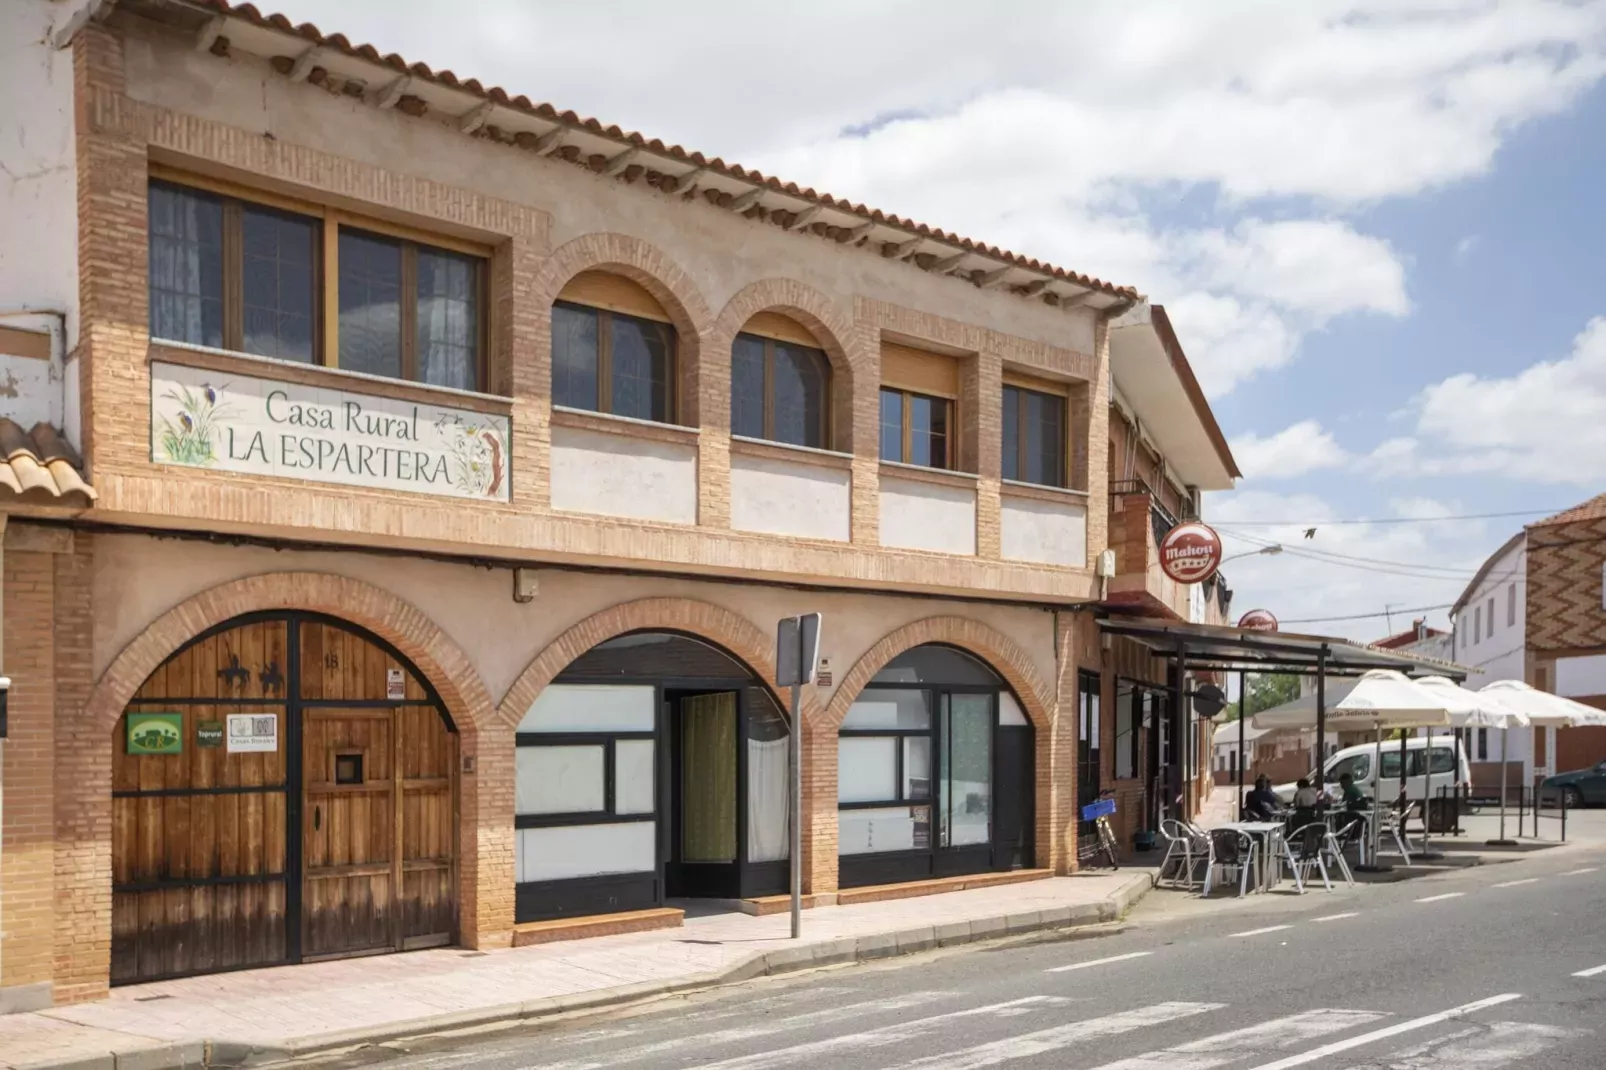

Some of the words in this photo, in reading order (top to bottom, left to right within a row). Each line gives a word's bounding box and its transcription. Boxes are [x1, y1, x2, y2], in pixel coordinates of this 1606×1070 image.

[266, 391, 335, 430] Casa
[344, 401, 420, 442] Rural
[228, 427, 270, 465] LA
[280, 434, 454, 485] ESPARTERA
[1165, 543, 1213, 560] Mahou
